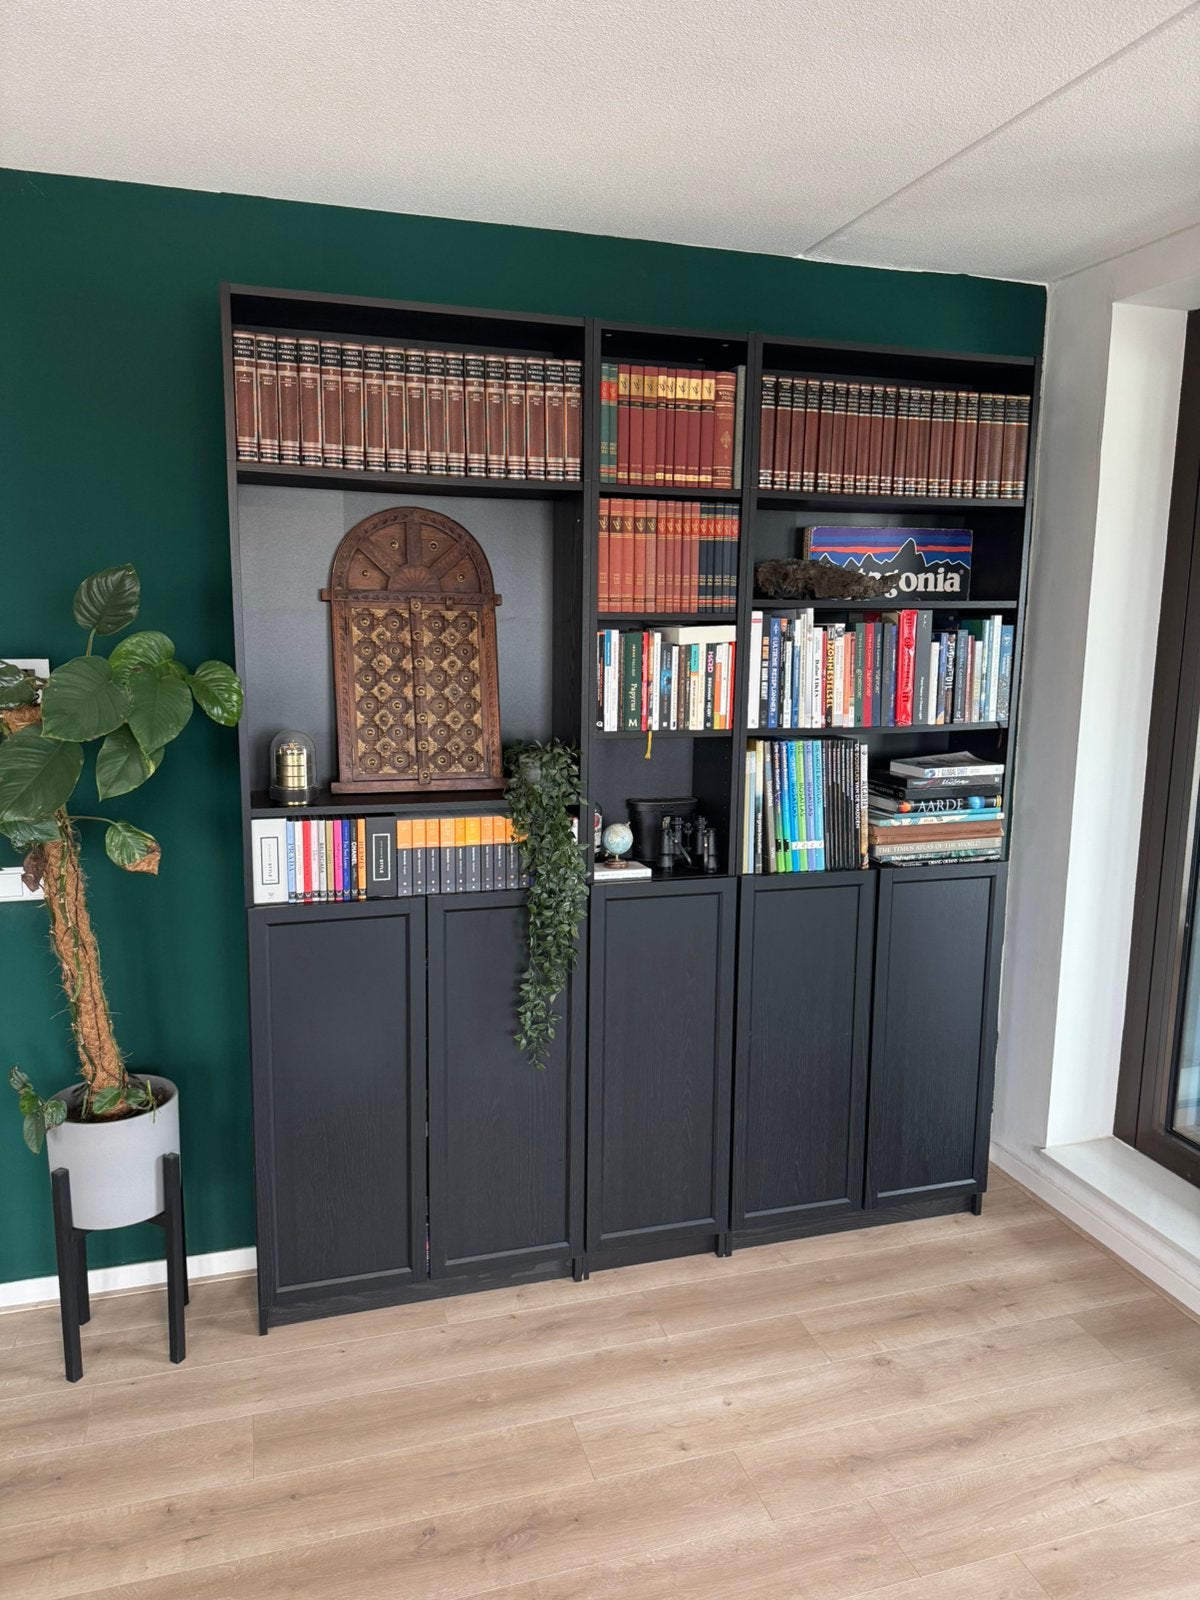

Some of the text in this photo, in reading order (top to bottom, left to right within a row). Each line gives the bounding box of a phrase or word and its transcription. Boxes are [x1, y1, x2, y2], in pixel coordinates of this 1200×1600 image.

[826, 643, 834, 708] ZONNESTELSEL
[629, 683, 637, 711] Papyrus
[918, 798, 964, 812] AARDE
